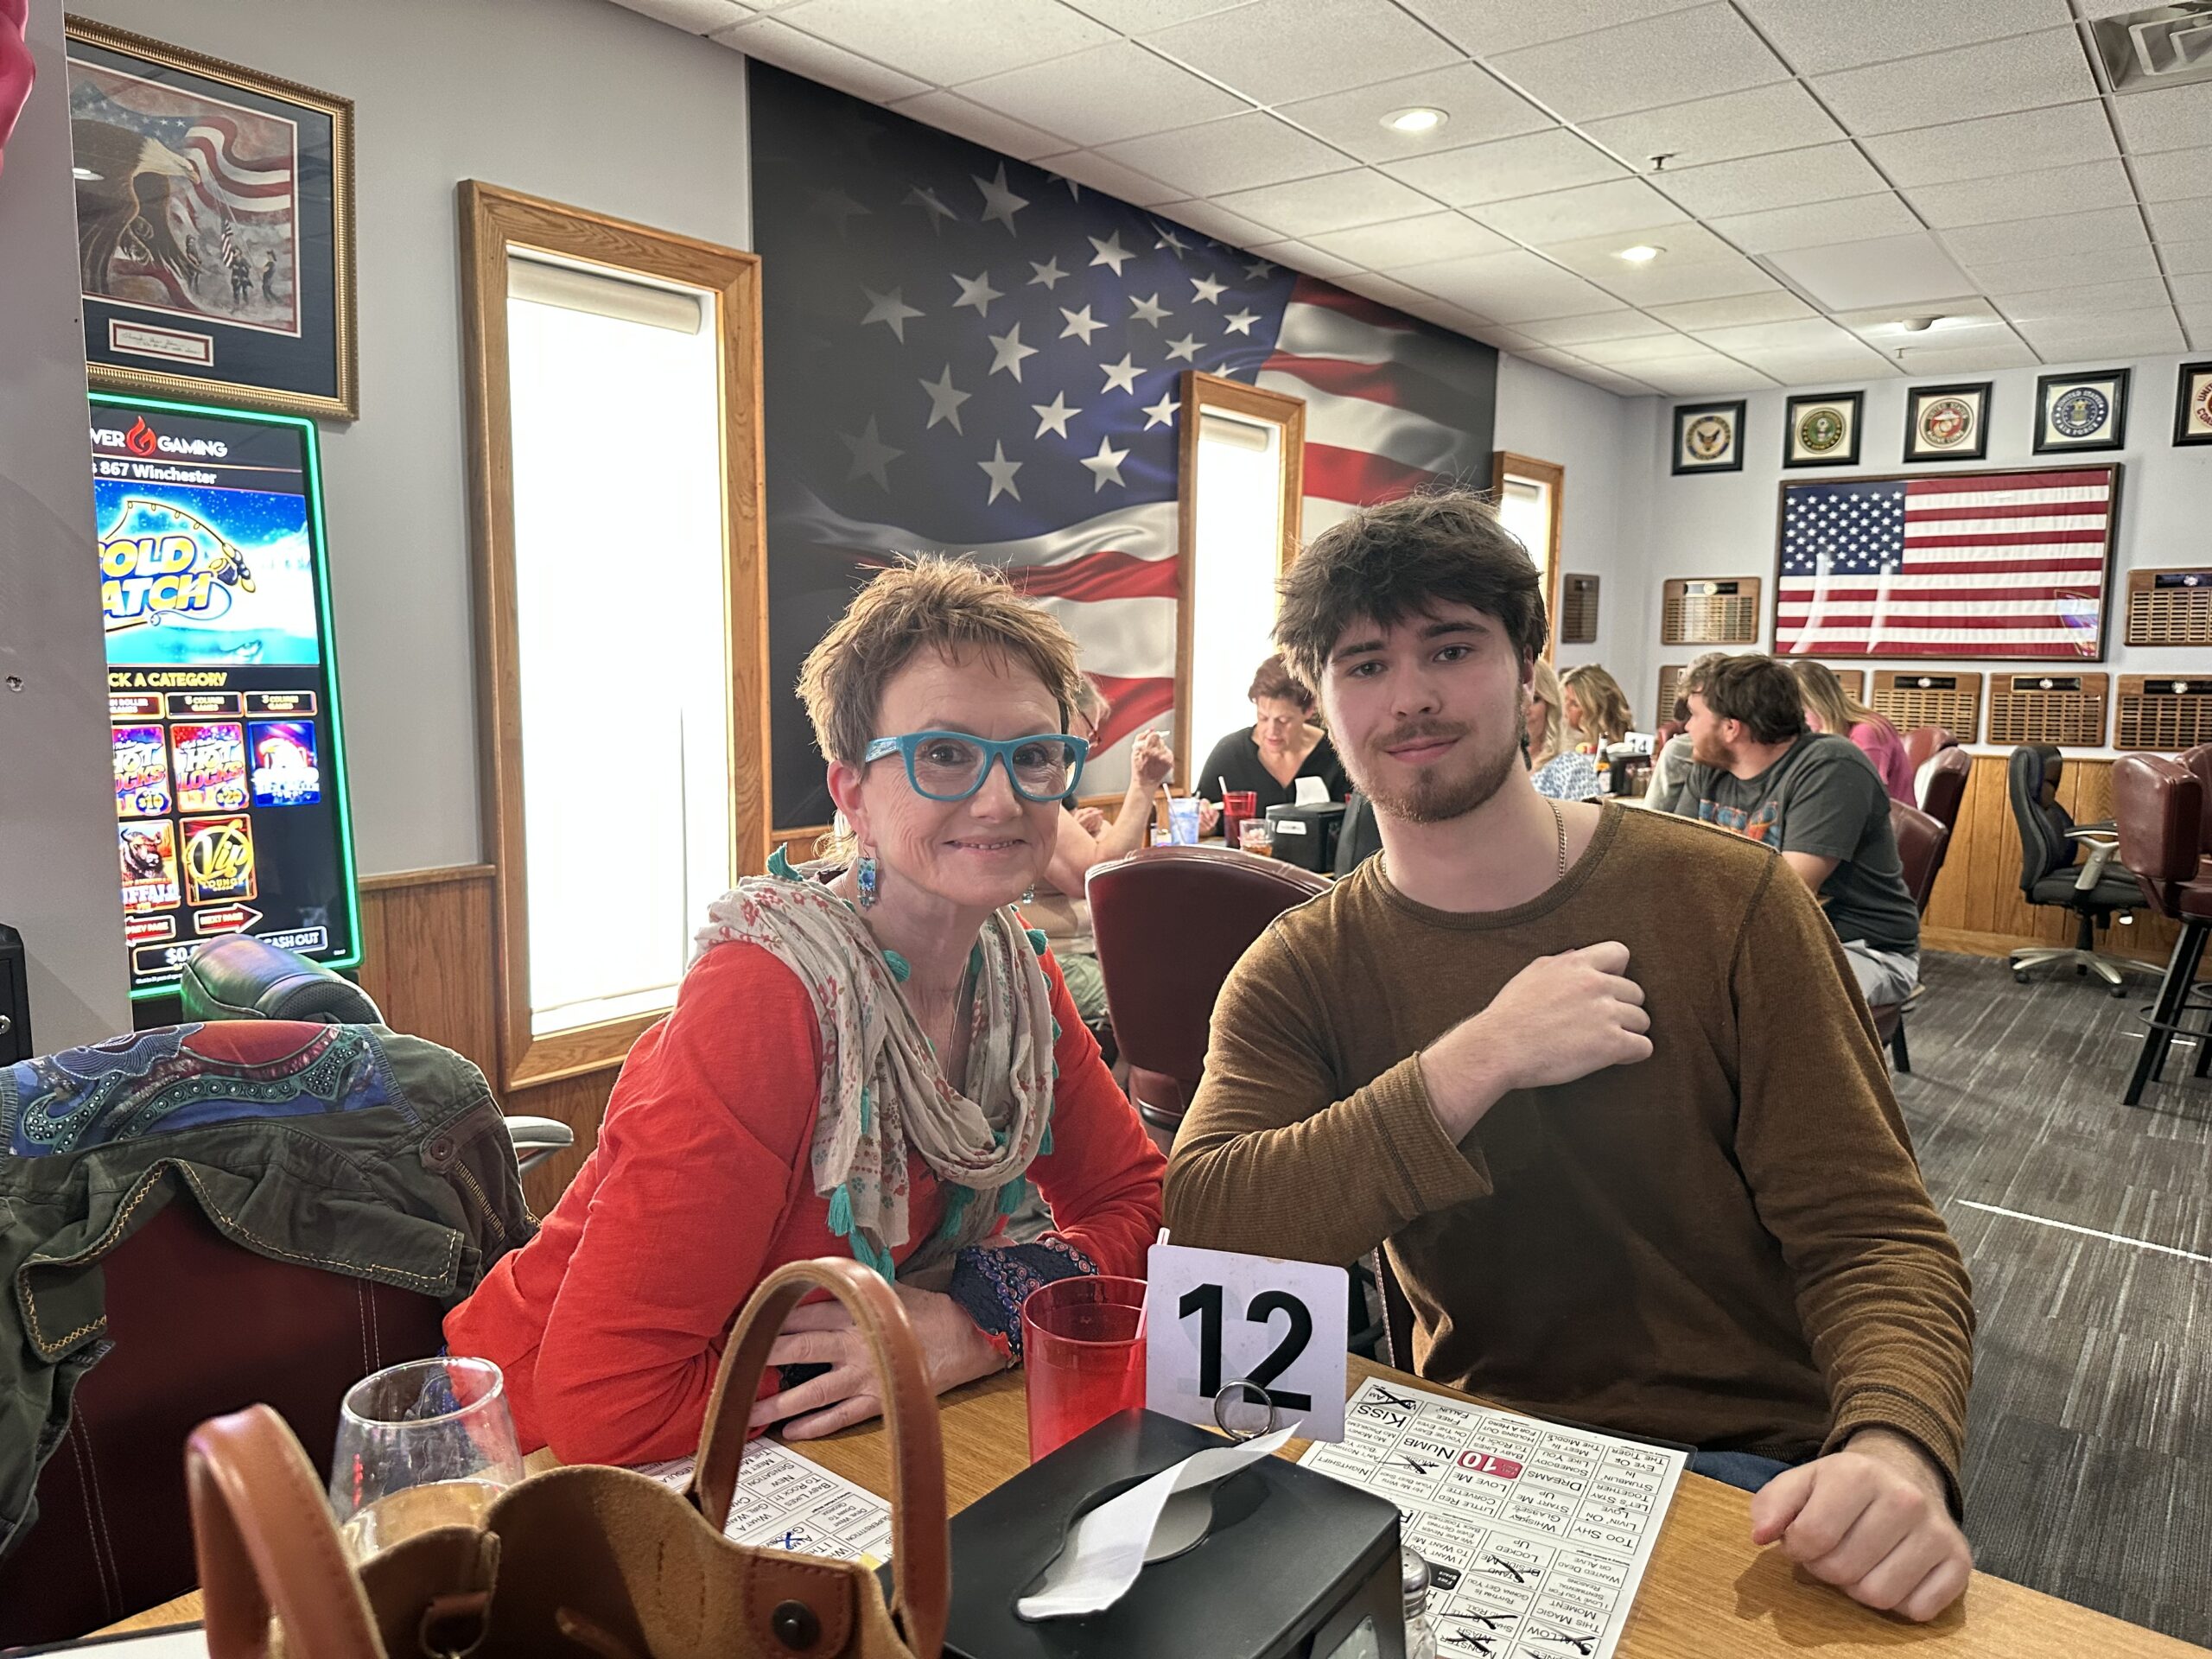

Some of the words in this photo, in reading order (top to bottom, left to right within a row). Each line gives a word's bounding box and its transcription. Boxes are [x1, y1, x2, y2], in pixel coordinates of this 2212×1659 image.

[2197, 383, 2212, 402] UNI
[157, 435, 228, 458] GAMING
[99, 461, 130, 476] 867
[132, 463, 217, 484] Winchester
[99, 537, 197, 578] OLD
[134, 672, 148, 687] A
[148, 672, 227, 687] CATEGORY
[1630, 739, 1647, 753] 14
[185, 741, 241, 772] HOT
[180, 761, 245, 791] LOCKS
[295, 931, 320, 946] OUT
[1179, 1282, 1313, 1412] 12
[1357, 1404, 1407, 1428] KISS
[1434, 1406, 1470, 1419] FALLIN'
[1435, 1414, 1461, 1426] FREE
[1487, 1420, 1510, 1430] HERO
[1348, 1427, 1372, 1439] MONEY
[1437, 1426, 1452, 1434] THE
[1453, 1429, 1467, 1438] ON
[1482, 1425, 1499, 1434] OUT
[1519, 1427, 1536, 1437] FOR
[1487, 1437, 1513, 1449] ROCK
[1500, 1430, 1535, 1443] HOLDING
[1547, 1433, 1580, 1446] MIDDLE
[1402, 1437, 1455, 1459] NUMB
[1472, 1441, 1497, 1453] LIKES
[1514, 1445, 1527, 1453] TO
[1563, 1446, 1589, 1457] MEET
[1581, 1442, 1599, 1452] THE
[1611, 1446, 1640, 1460] TIGER
[1499, 1449, 1524, 1460] BABY
[1541, 1450, 1563, 1462] YOU
[1643, 1454, 1663, 1465] THE
[750, 1458, 775, 1471] MEET
[1317, 1456, 1370, 1476] NIGHTSHIFT
[1458, 1449, 1502, 1474] 10
[1534, 1458, 1589, 1477] SOMEBODY
[1567, 1456, 1589, 1468] LIKE
[1633, 1461, 1655, 1472] EYE
[746, 1462, 795, 1486] SENSATION
[770, 1474, 795, 1487] NEW
[804, 1476, 822, 1484] TO
[1452, 1472, 1473, 1484] ME
[1527, 1470, 1582, 1491] DREAMS
[1624, 1470, 1636, 1478] IN
[781, 1482, 808, 1496] ROCK
[807, 1481, 831, 1495] BABY
[1475, 1478, 1507, 1492] LOVE
[1599, 1474, 1654, 1492] STUMBLIN'
[783, 1492, 810, 1506] LIKES
[1438, 1494, 1460, 1506] RED
[1446, 1486, 1496, 1505] CORVETTE
[1516, 1494, 1534, 1504] ME
[1538, 1491, 1555, 1500] UP
[1589, 1491, 1617, 1504] STAY
[1596, 1484, 1649, 1503] TOGETHER
[746, 1503, 769, 1514] GIRL
[1461, 1500, 1494, 1515] LITTLE
[1535, 1499, 1570, 1514] START
[1618, 1498, 1649, 1512] LET'S
[1511, 1504, 1561, 1522] GLASSES
[1585, 1511, 1604, 1522] ON
[1601, 1505, 1629, 1519] LOVE
[745, 1513, 772, 1527] WHAT
[1508, 1514, 1555, 1533] WHISKEY
[1605, 1517, 1637, 1532] LIVIN'
[1573, 1525, 1602, 1539] SHY
[1413, 1535, 1427, 1545] ME
[1428, 1540, 1453, 1553] WANT
[1512, 1539, 1530, 1549] UP
[1605, 1533, 1633, 1548] TOO
[1406, 1542, 1430, 1555] YOU
[1455, 1548, 1468, 1558] TO
[1495, 1544, 1538, 1563] LOCKED
[1430, 1550, 1456, 1563] WANT
[1573, 1557, 1598, 1568] ALIVE
[1557, 1560, 1582, 1573] DEAD
[1434, 1575, 1453, 1586] FREE
[1436, 1569, 1459, 1580] SPACE
[1583, 1568, 1619, 1584] WANTED
[1466, 1578, 1483, 1587] YOU
[1484, 1583, 1501, 1592] GET
[1567, 1577, 1601, 1592] REASONS
[1503, 1588, 1529, 1601] GONNA
[1548, 1586, 1564, 1597] FOR
[1559, 1582, 1605, 1600] SENTIMENTAL
[1564, 1592, 1581, 1602] YOU
[1583, 1597, 1604, 1608] LOVE
[1535, 1607, 1573, 1625] MAGIC
[1548, 1599, 1597, 1620] MOMENT
[1574, 1618, 1599, 1634] THIS
